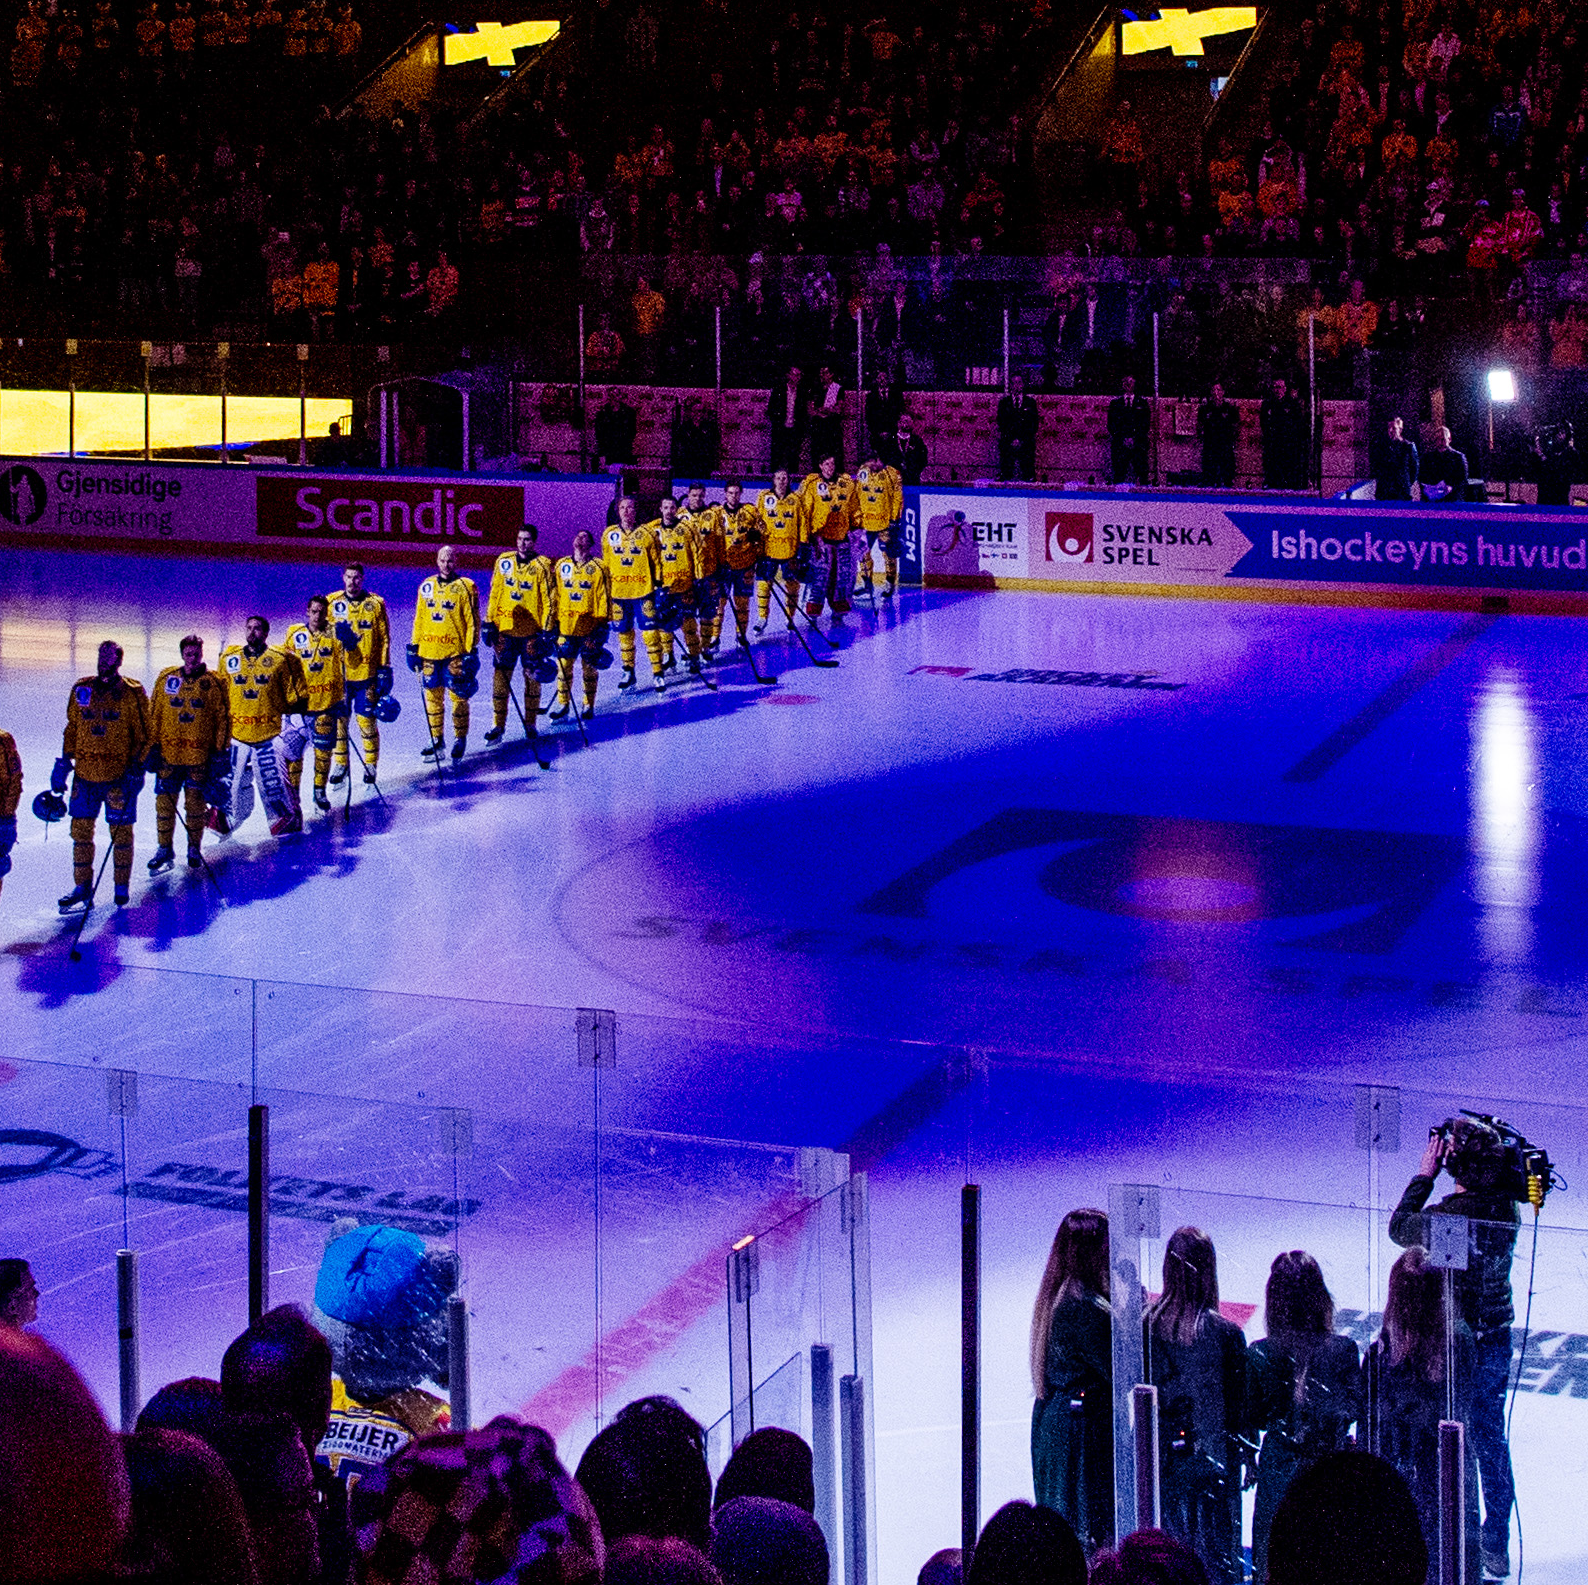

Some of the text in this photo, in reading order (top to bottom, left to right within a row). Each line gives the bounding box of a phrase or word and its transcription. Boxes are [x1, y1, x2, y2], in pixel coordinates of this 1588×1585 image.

[57, 471, 182, 500] Gjensidige
[295, 487, 485, 539] Scandic
[904, 508, 917, 563] CCM
[1103, 524, 1213, 546] SVENSKA
[1270, 528, 1470, 572] Ishockeyns
[1103, 546, 1161, 567] SPEL
[326, 1421, 398, 1452] BEIJER
